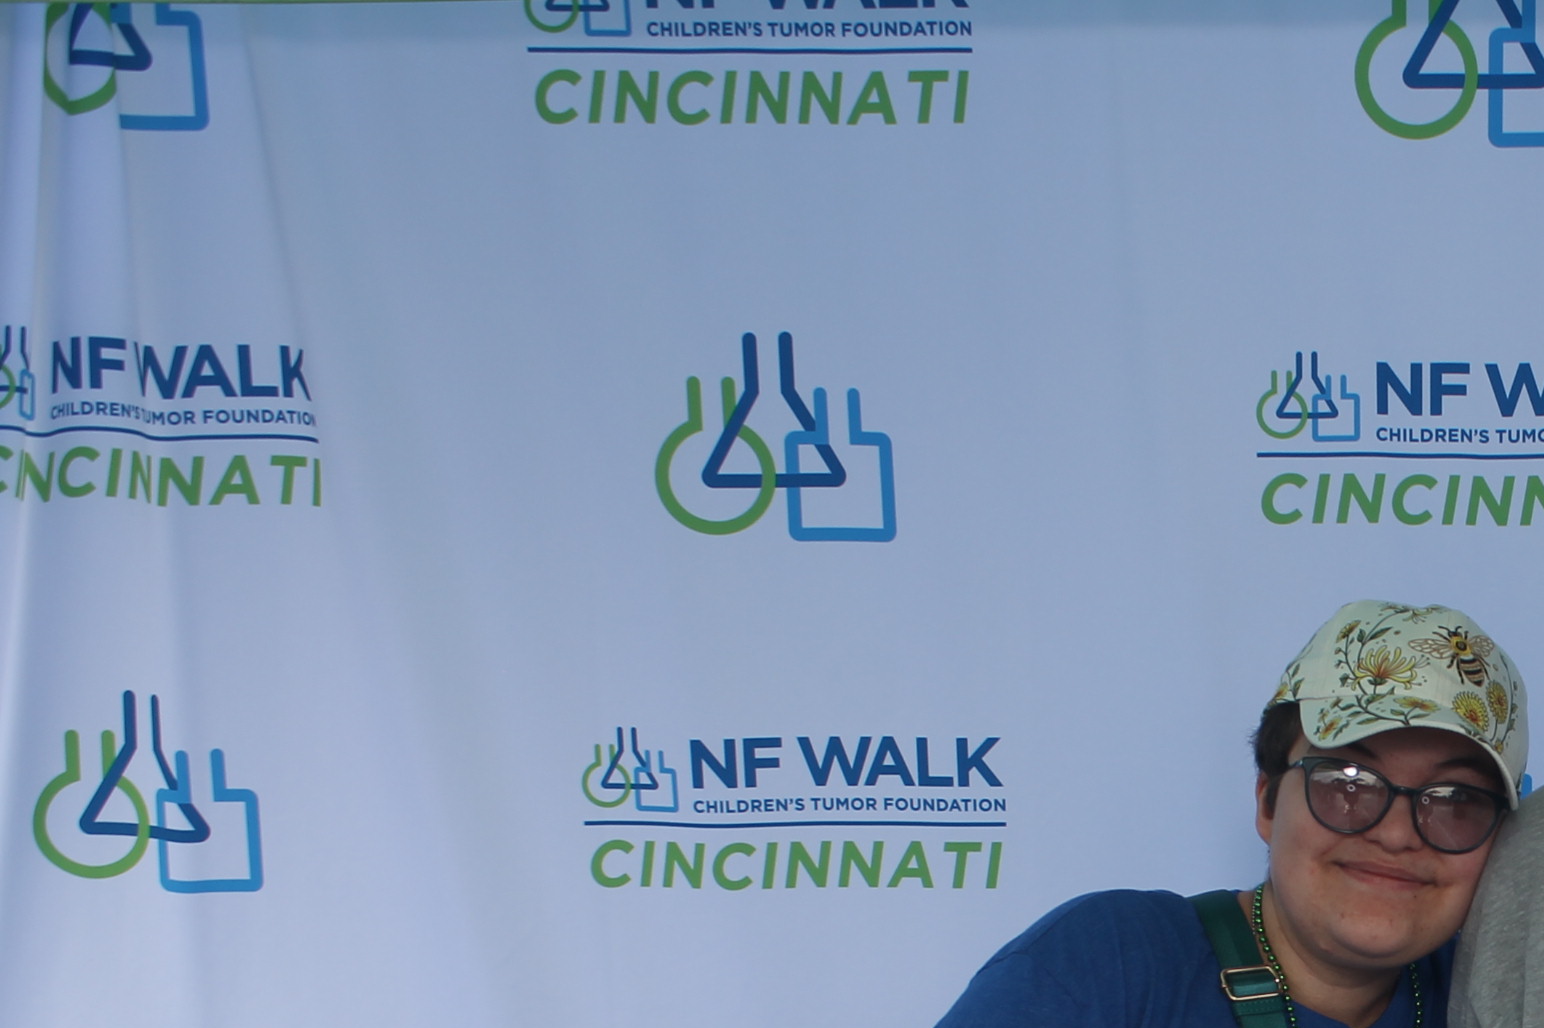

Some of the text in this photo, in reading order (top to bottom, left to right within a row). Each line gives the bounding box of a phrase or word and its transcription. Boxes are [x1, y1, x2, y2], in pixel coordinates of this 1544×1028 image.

[647, 21, 971, 37] CHILDREN'S TUMOR FOUNDATION
[535, 69, 969, 125] CINCINNATI
[52, 337, 311, 401] NF WALK
[1376, 362, 1470, 416] NF
[1376, 428, 1489, 443] CHILDREN'S
[690, 736, 1003, 789] NF WALK
[694, 798, 1006, 813] CHILDREN'S TUMOR FOUNDATION
[591, 840, 1002, 891] CINCINNATI
